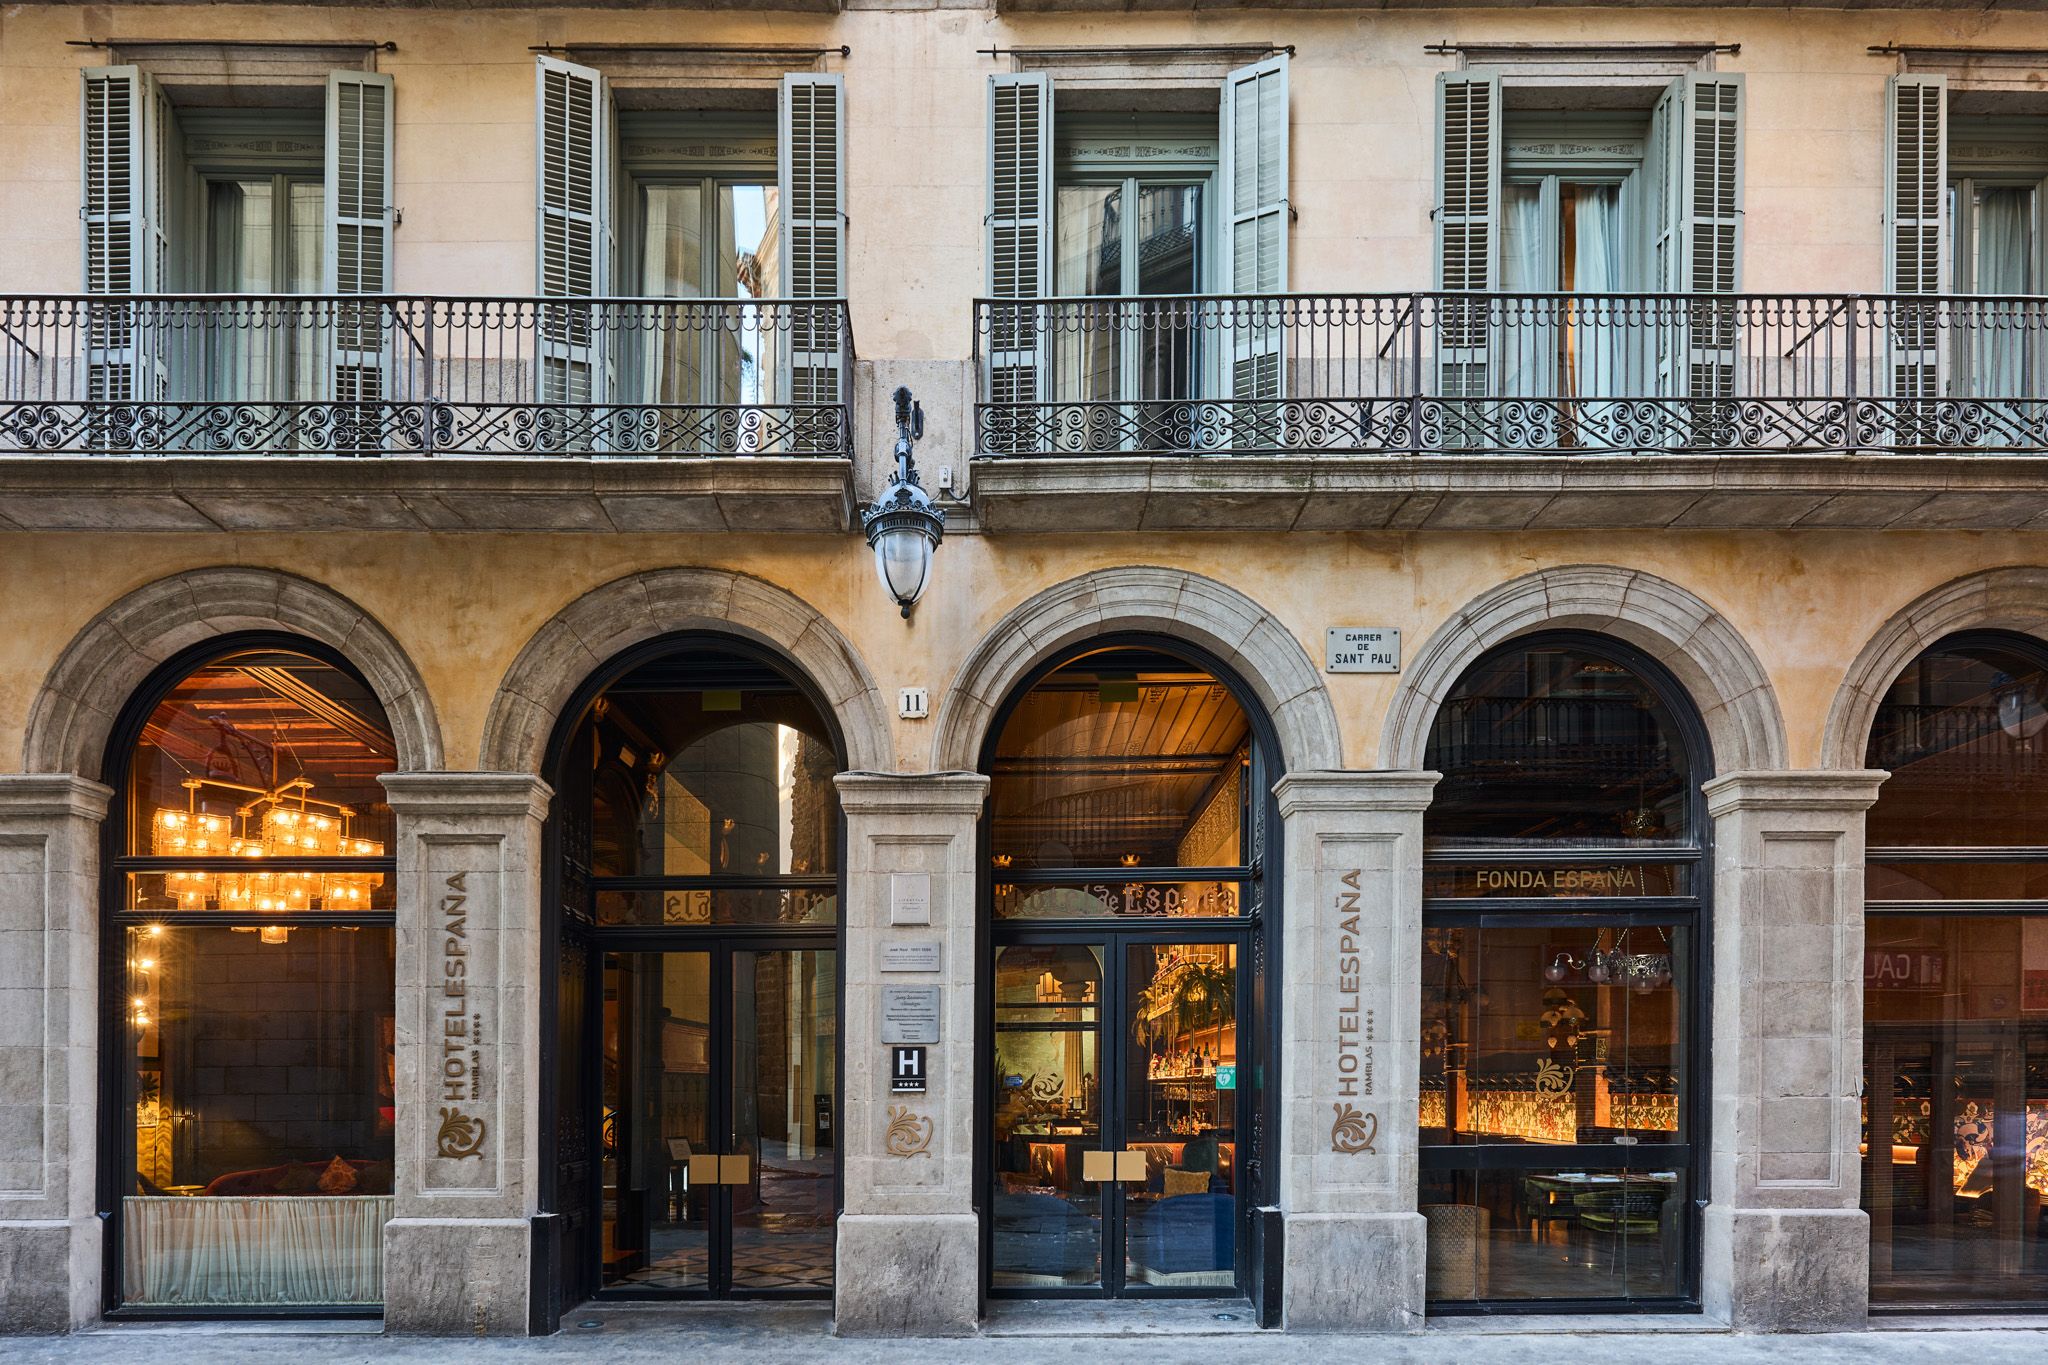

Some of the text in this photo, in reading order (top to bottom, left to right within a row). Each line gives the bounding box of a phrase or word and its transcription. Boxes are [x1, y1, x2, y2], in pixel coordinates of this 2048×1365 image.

[1345, 634, 1382, 642] CARRER
[1357, 643, 1369, 651] DE
[1335, 653, 1392, 664] SANT PAU
[905, 694, 921, 712] 11
[1476, 866, 1636, 888] FONDA ESPAÑA
[899, 1050, 919, 1076] H
[1364, 1046, 1373, 1096] RAMBLAS
[471, 1050, 480, 1100] RAMBLAS
